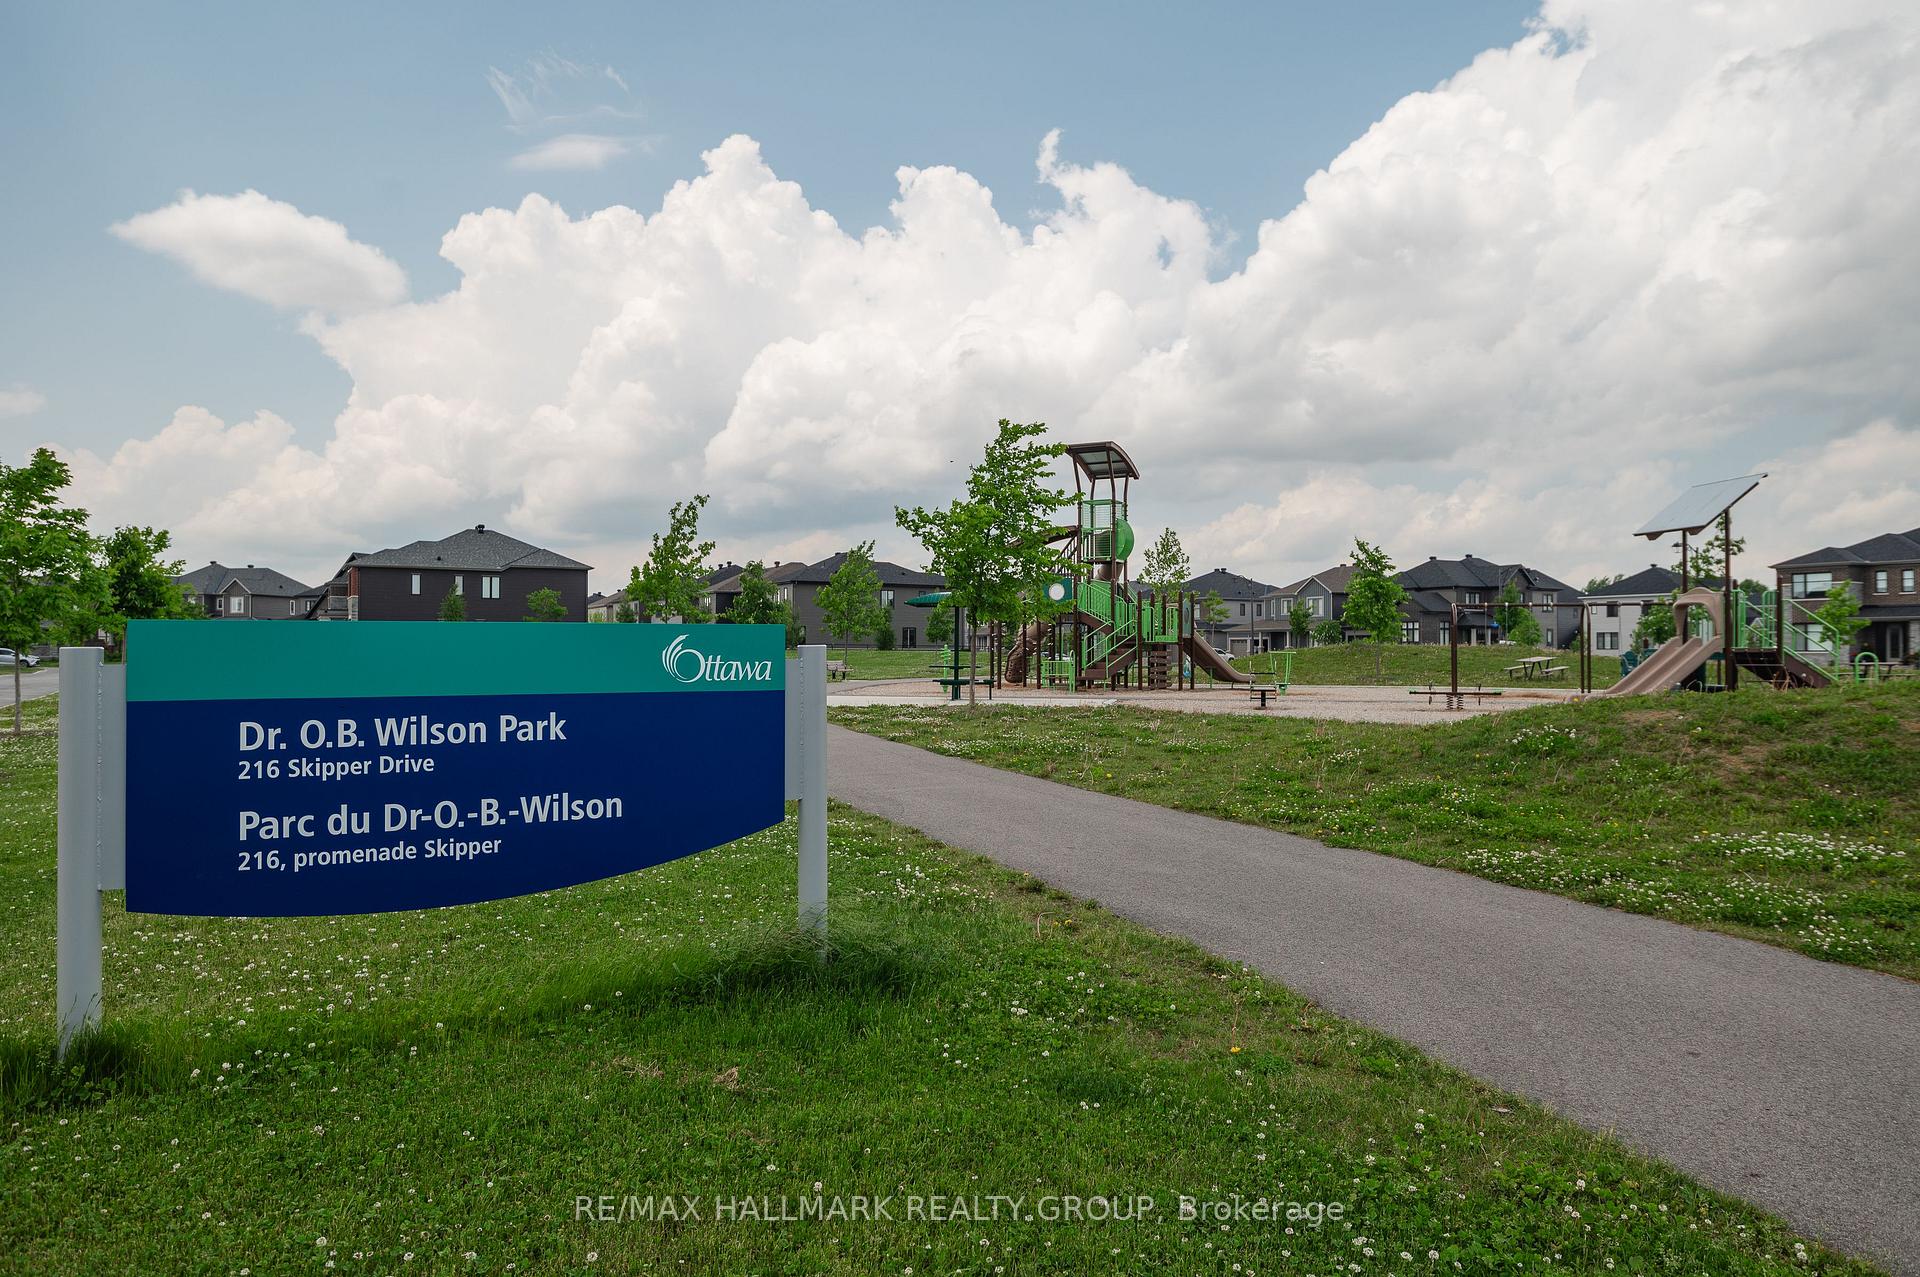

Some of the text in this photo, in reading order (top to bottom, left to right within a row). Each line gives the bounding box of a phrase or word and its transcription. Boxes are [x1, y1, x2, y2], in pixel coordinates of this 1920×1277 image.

[663, 636, 772, 683] Ottawa
[239, 711, 567, 751] Dr. O.B. Wilson Park
[238, 753, 435, 782] 216 Skipper Drive
[239, 792, 622, 841] Parc du Dr-O.-B.-Wilson
[238, 837, 502, 873] 216, promenade Skipper
